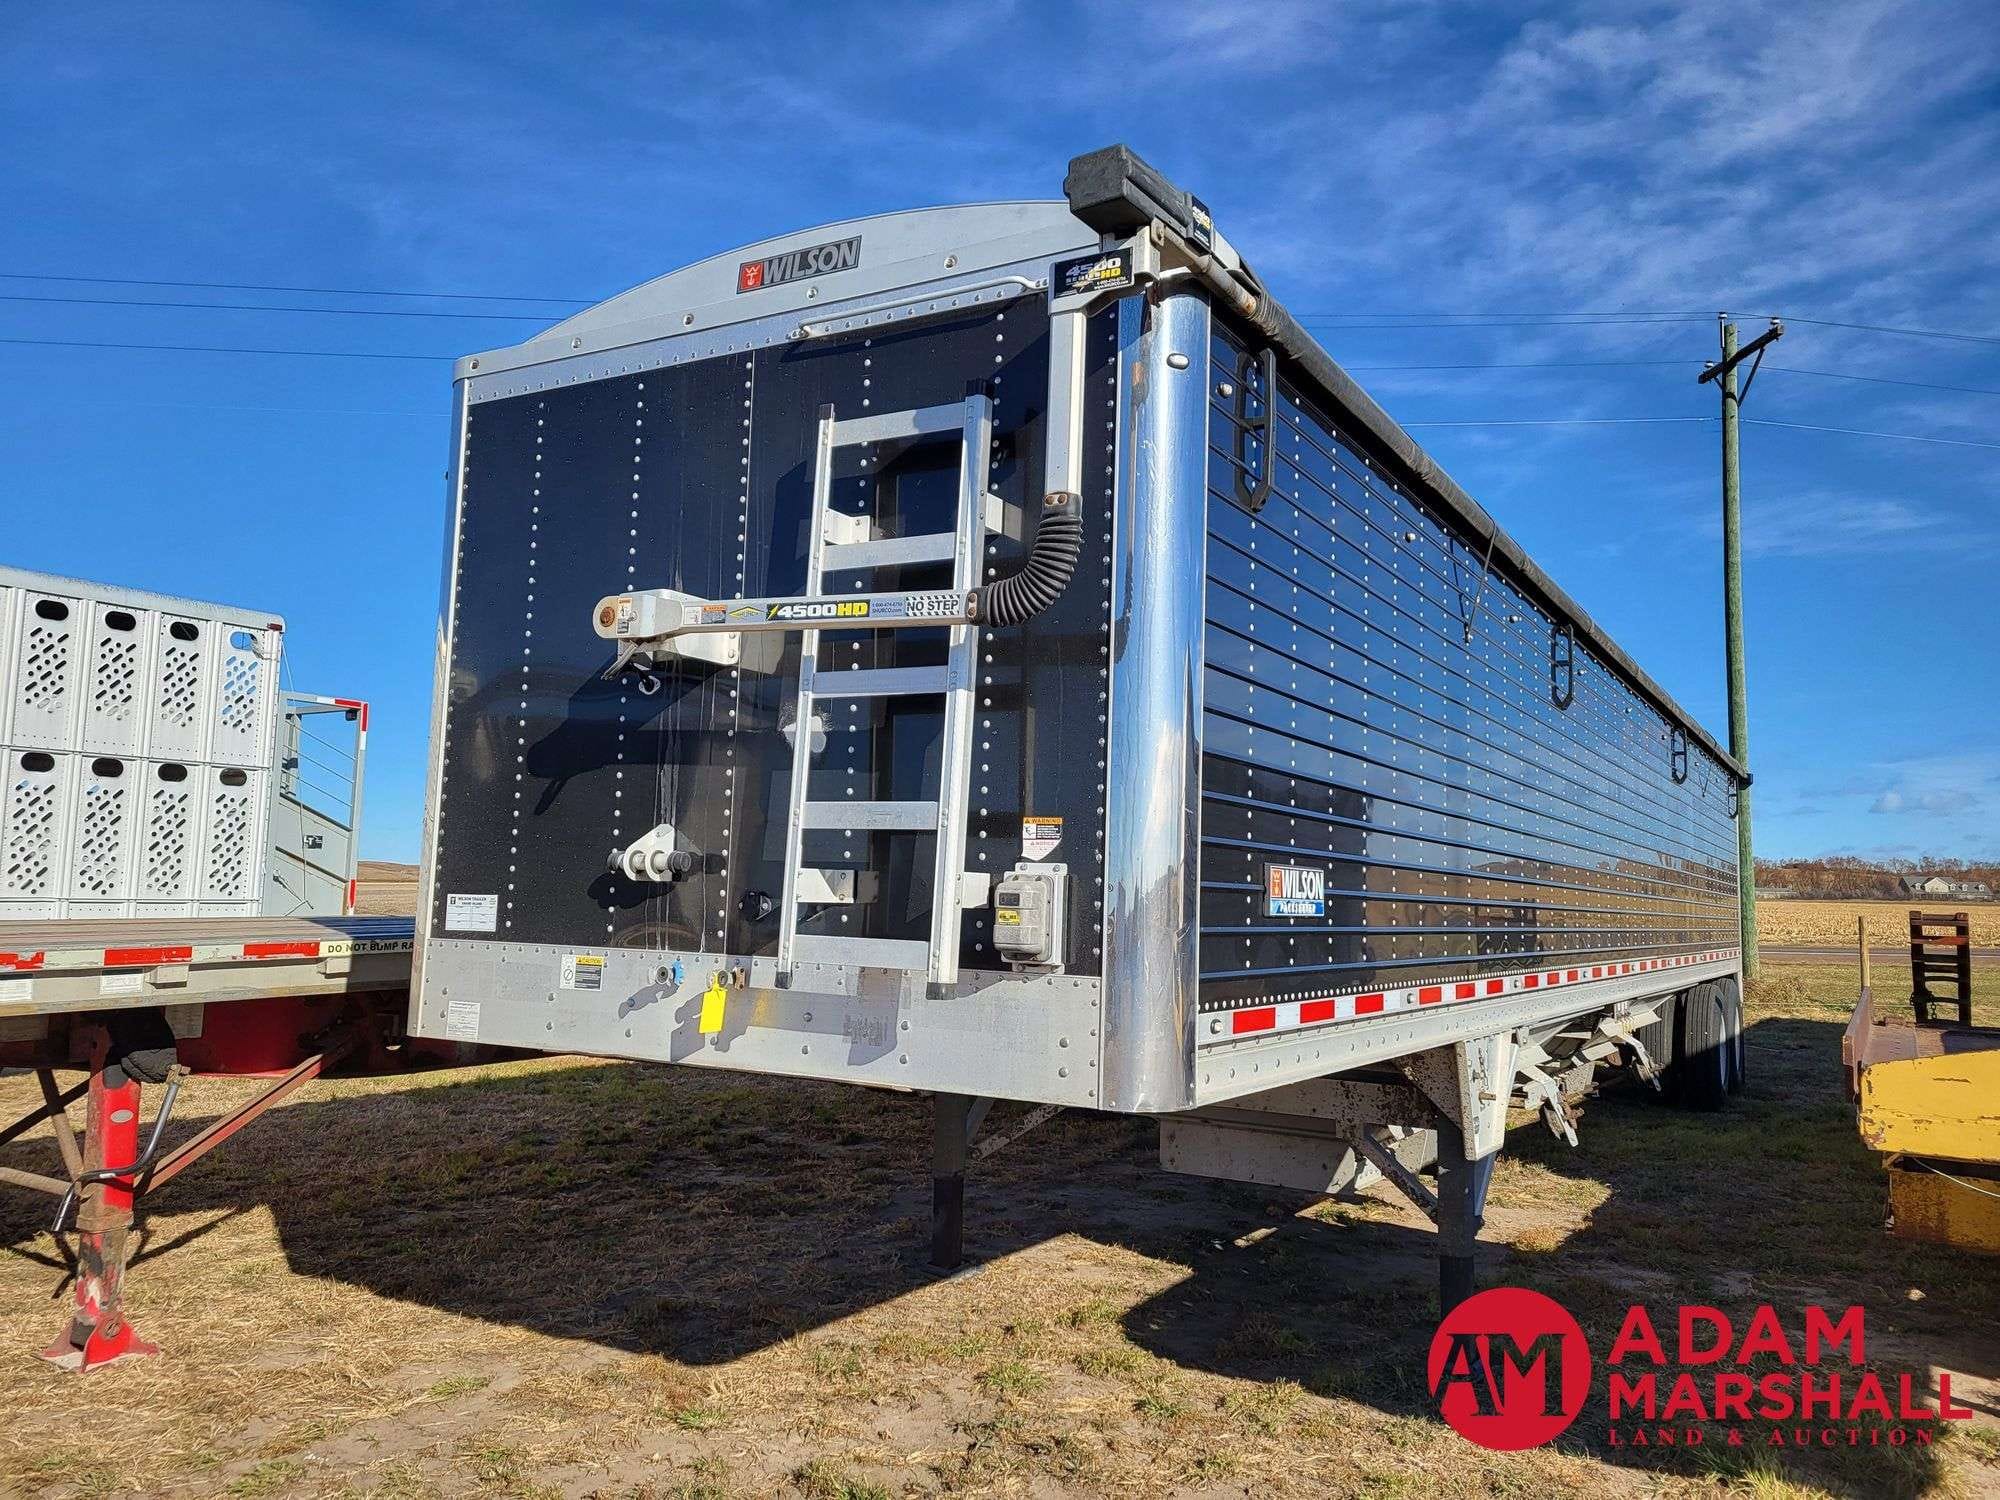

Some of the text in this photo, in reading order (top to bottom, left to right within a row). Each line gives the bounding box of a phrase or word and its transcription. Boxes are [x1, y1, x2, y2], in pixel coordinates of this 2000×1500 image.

[763, 239, 859, 285] WILSON
[906, 600, 959, 611] NO STEP
[1282, 870, 1325, 900] WILSON
[327, 944, 343, 953] DO
[345, 943, 367, 952] NOT
[369, 941, 399, 951] BUMP
